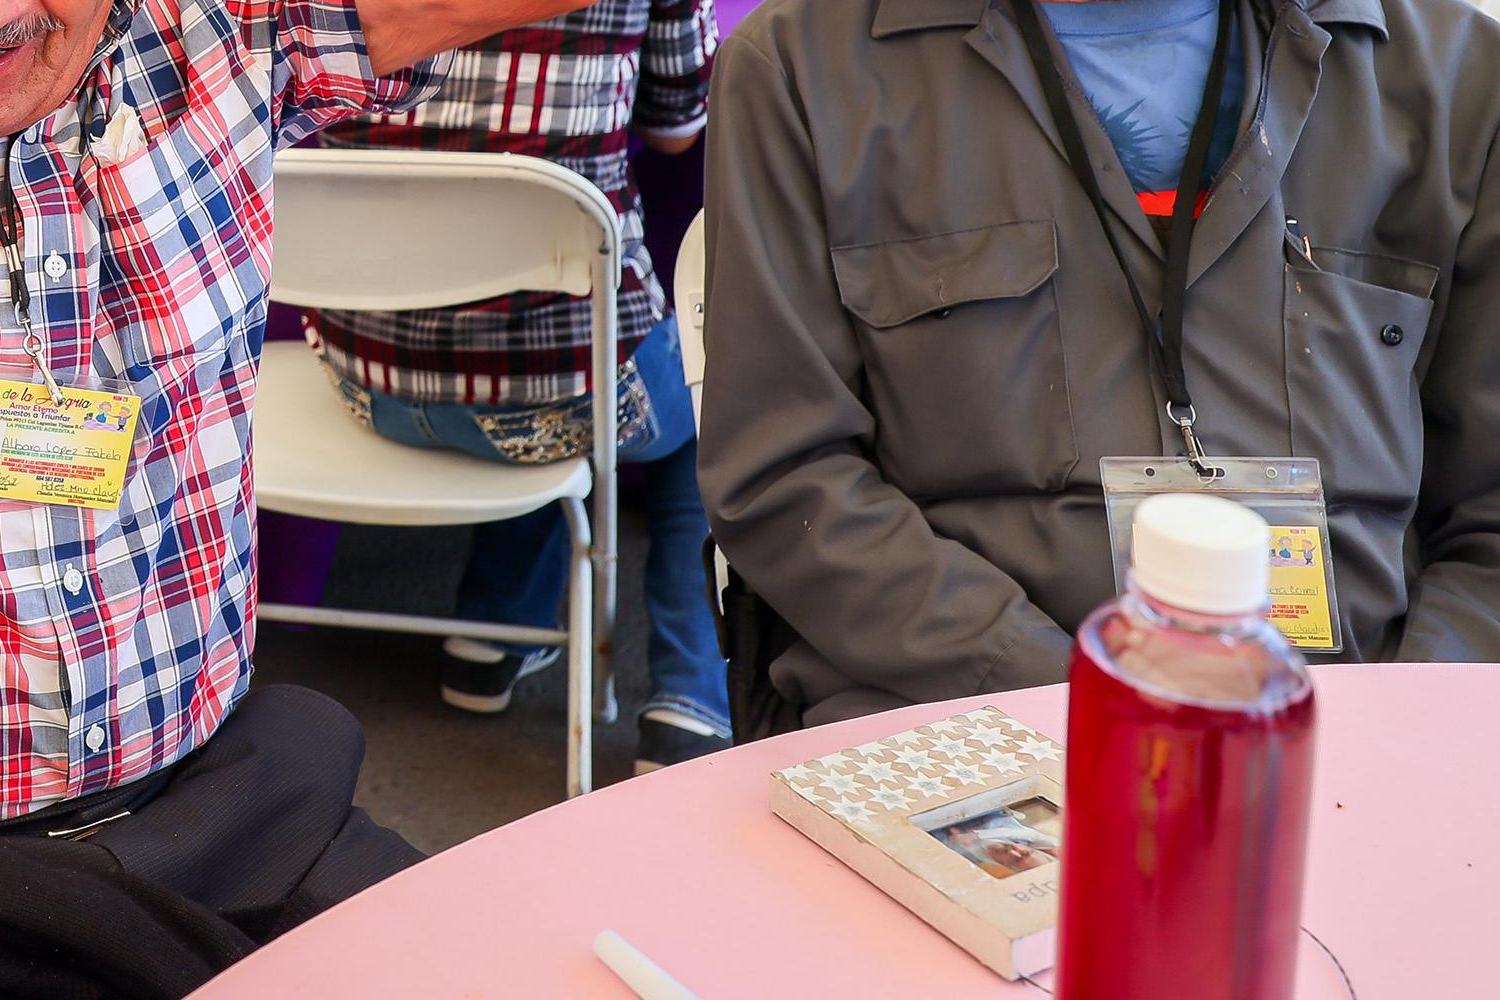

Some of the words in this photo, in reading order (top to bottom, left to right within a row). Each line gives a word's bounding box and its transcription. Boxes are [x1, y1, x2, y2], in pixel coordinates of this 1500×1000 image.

[2, 388, 18, 399] de
[21, 387, 35, 402] la
[9, 402, 31, 411] Amor
[41, 411, 71, 422] Triunfar
[14, 424, 42, 432] PRESENTE
